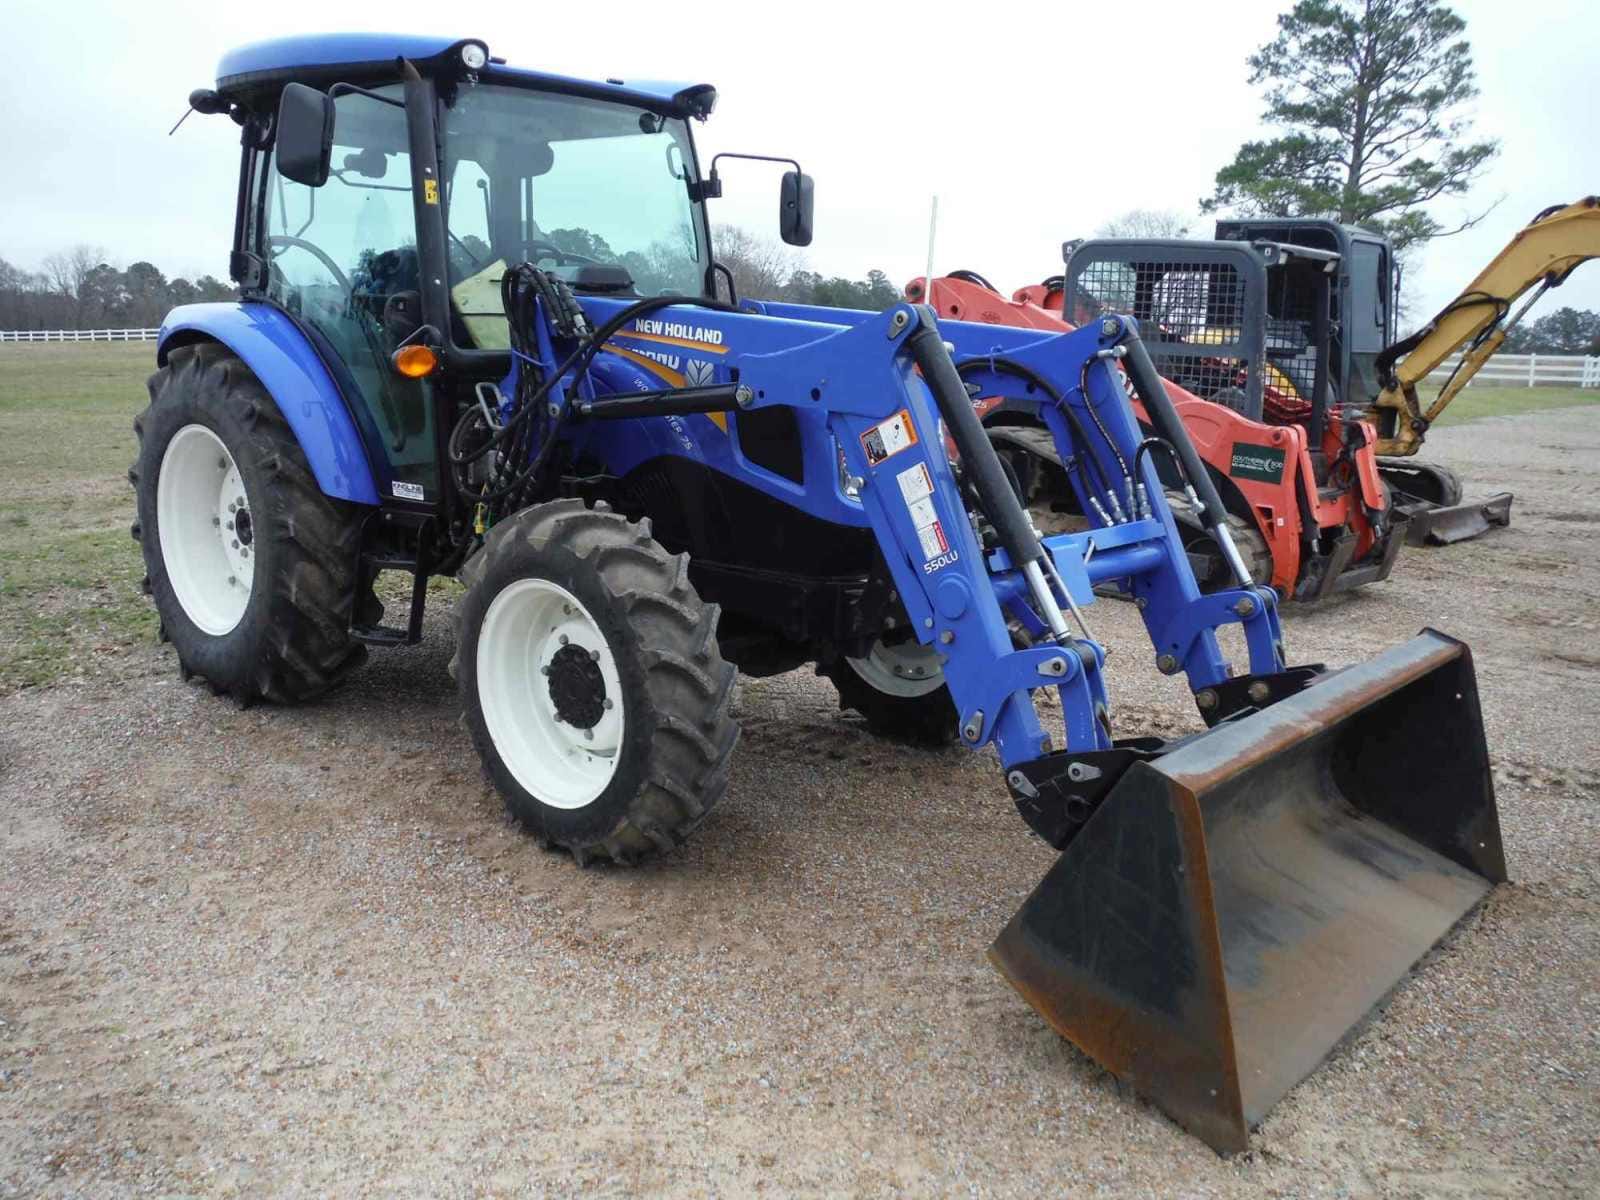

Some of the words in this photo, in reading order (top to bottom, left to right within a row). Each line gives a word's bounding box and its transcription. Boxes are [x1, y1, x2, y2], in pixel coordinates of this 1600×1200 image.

[635, 318, 663, 335] NEW
[665, 320, 722, 344] HOLLAND
[1232, 455, 1265, 466] SOUTHERN
[923, 550, 959, 575] 550LU
